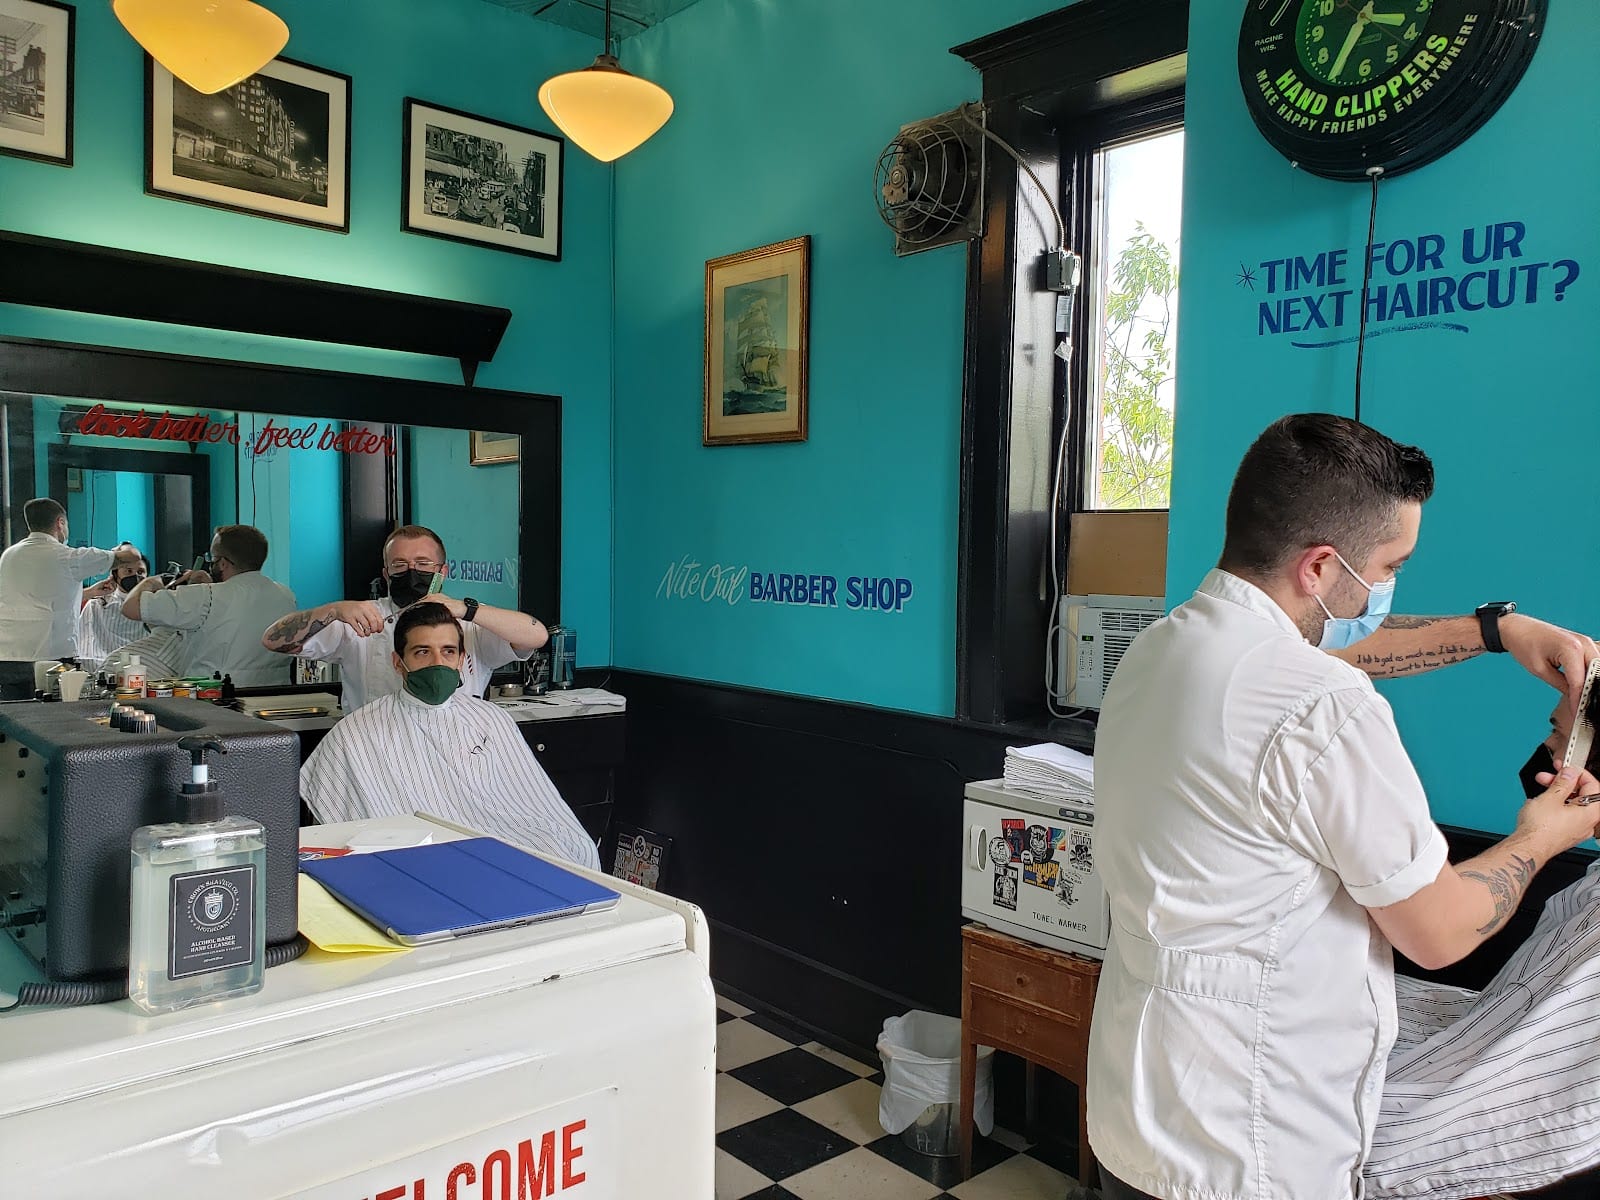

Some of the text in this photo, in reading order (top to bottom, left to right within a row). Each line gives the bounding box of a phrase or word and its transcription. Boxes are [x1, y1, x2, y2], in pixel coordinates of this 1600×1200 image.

[1319, 0, 1335, 17] 10
[1254, 33, 1283, 47] RACINE
[1311, 25, 1325, 43] 9
[1403, 22, 1418, 41] 4
[1317, 47, 1330, 65] 8
[1385, 44, 1399, 63] 5
[1256, 14, 1479, 134] MAKE HAPPY FRIENDS EVERYWHERE
[1275, 34, 1449, 118] HAND CLIPPERS
[1358, 58, 1371, 77] 6
[1259, 221, 1526, 294] TIME FOR UR
[1258, 259, 1580, 336] NEXT HAIRCUT?
[76, 403, 151, 438] look
[253, 418, 318, 454] feel
[317, 423, 397, 457] better
[655, 553, 913, 614] Nite Owl BARBER SHOP
[1032, 911, 1087, 932] TOWEL WARMER
[190, 945, 206, 953] HAND
[206, 940, 236, 950] CLEANSER
[191, 935, 236, 948] ALCOHOL BASED
[360, 1119, 587, 1200] COME
